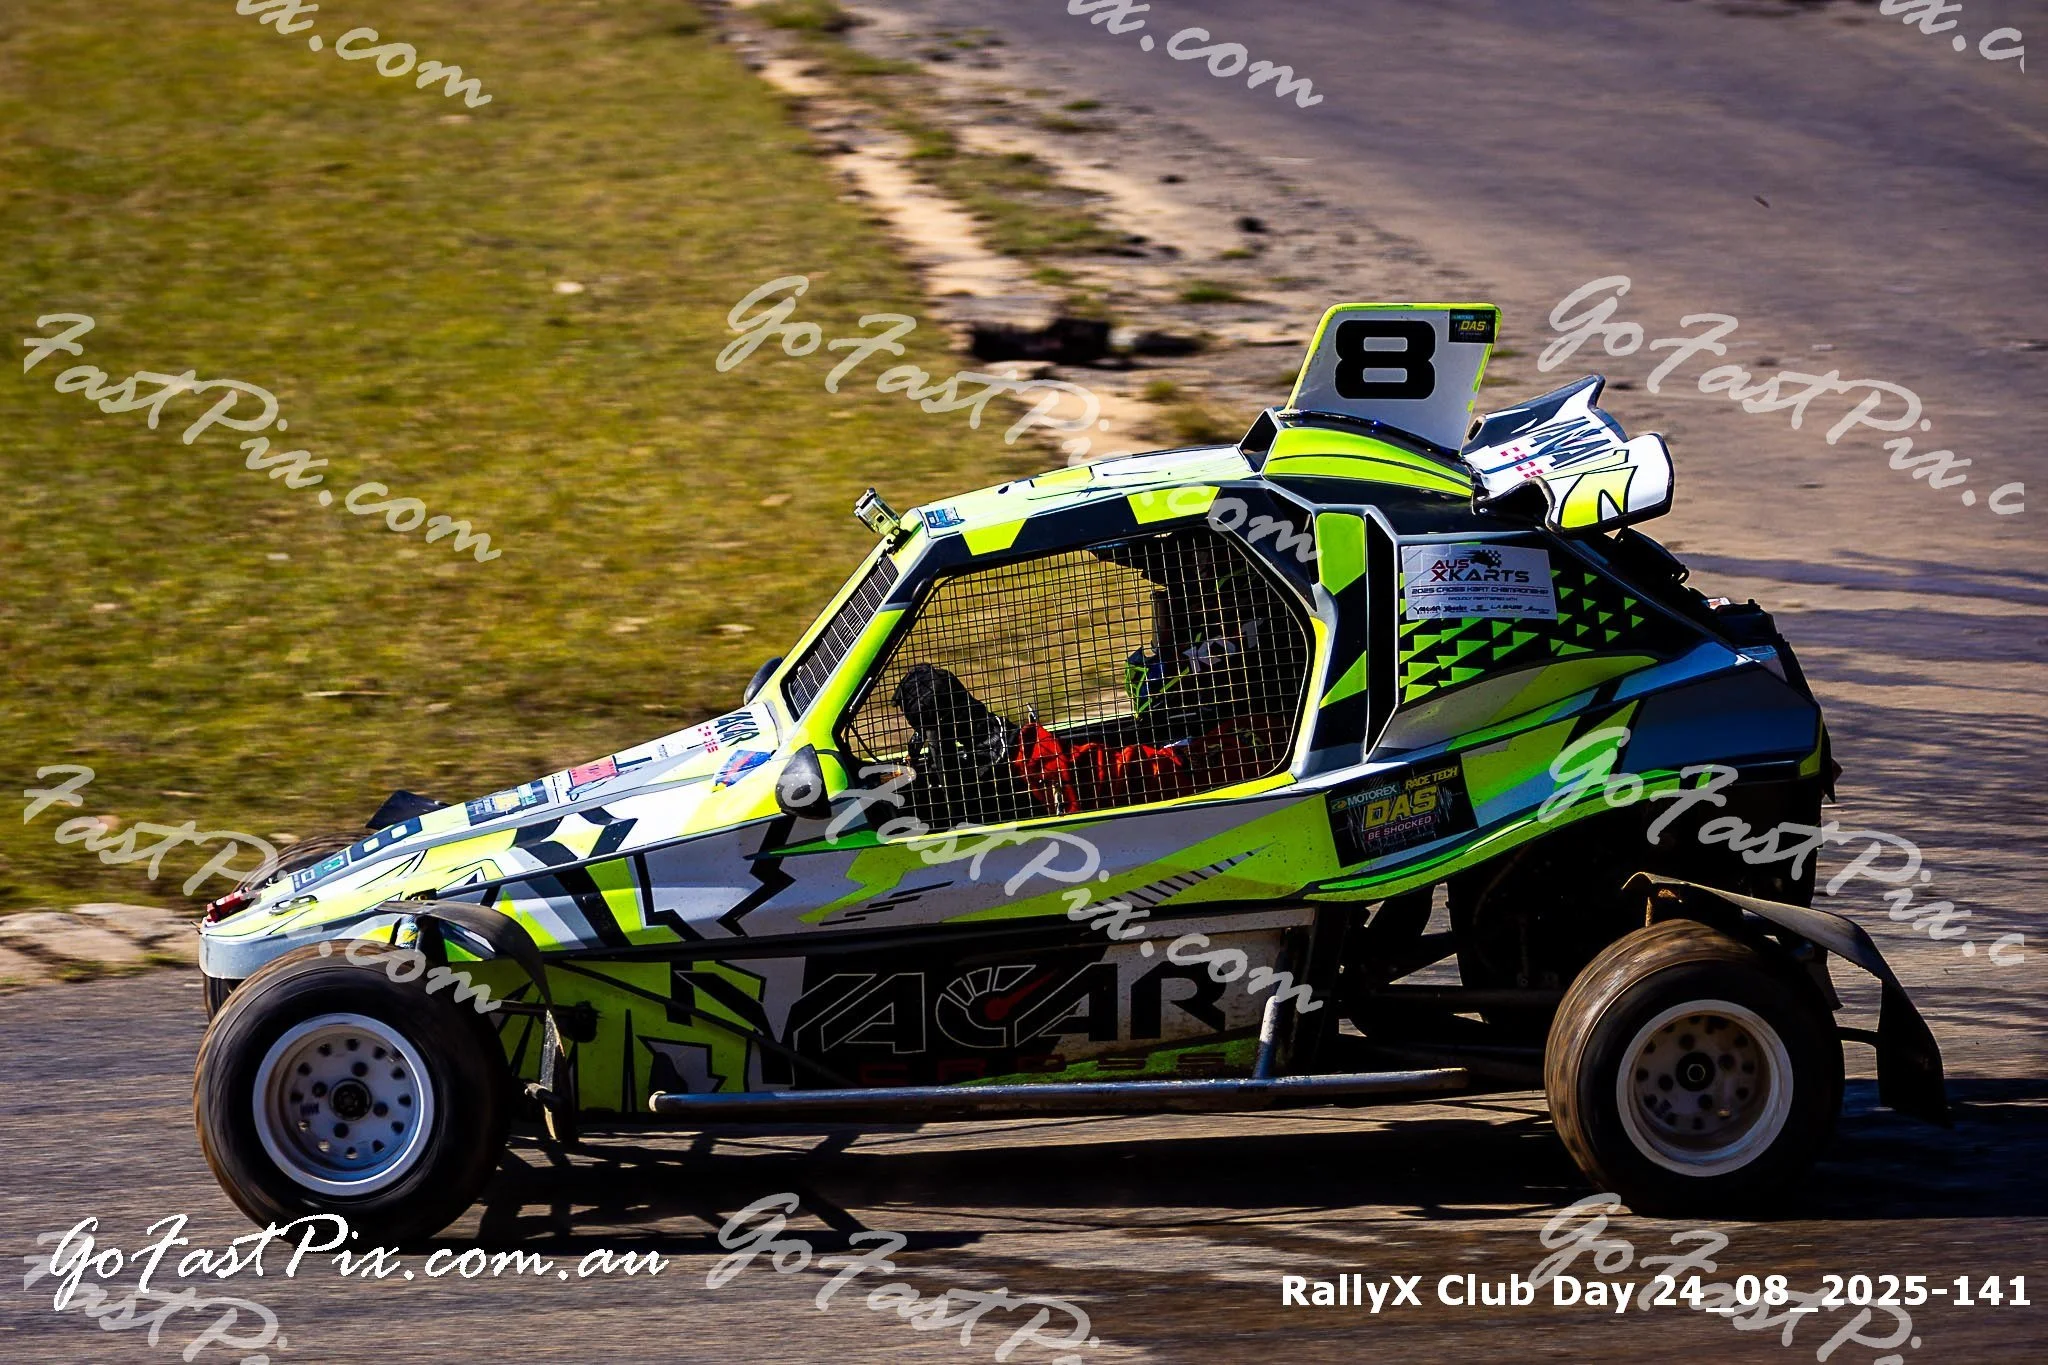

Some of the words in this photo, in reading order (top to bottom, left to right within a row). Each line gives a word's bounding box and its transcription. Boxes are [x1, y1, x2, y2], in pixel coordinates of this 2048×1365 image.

[1460, 320, 1487, 331] DAS
[1335, 320, 1436, 400] 8
[1431, 558, 1470, 570] AUS
[1430, 568, 1530, 583] XKARTS
[1405, 772, 1431, 789] RACE
[1432, 765, 1458, 783] TECH
[1347, 785, 1397, 806] MOTOREX
[1364, 785, 1437, 830] DAS
[1368, 831, 1380, 840] BE
[1383, 815, 1432, 836] SHOCKED
